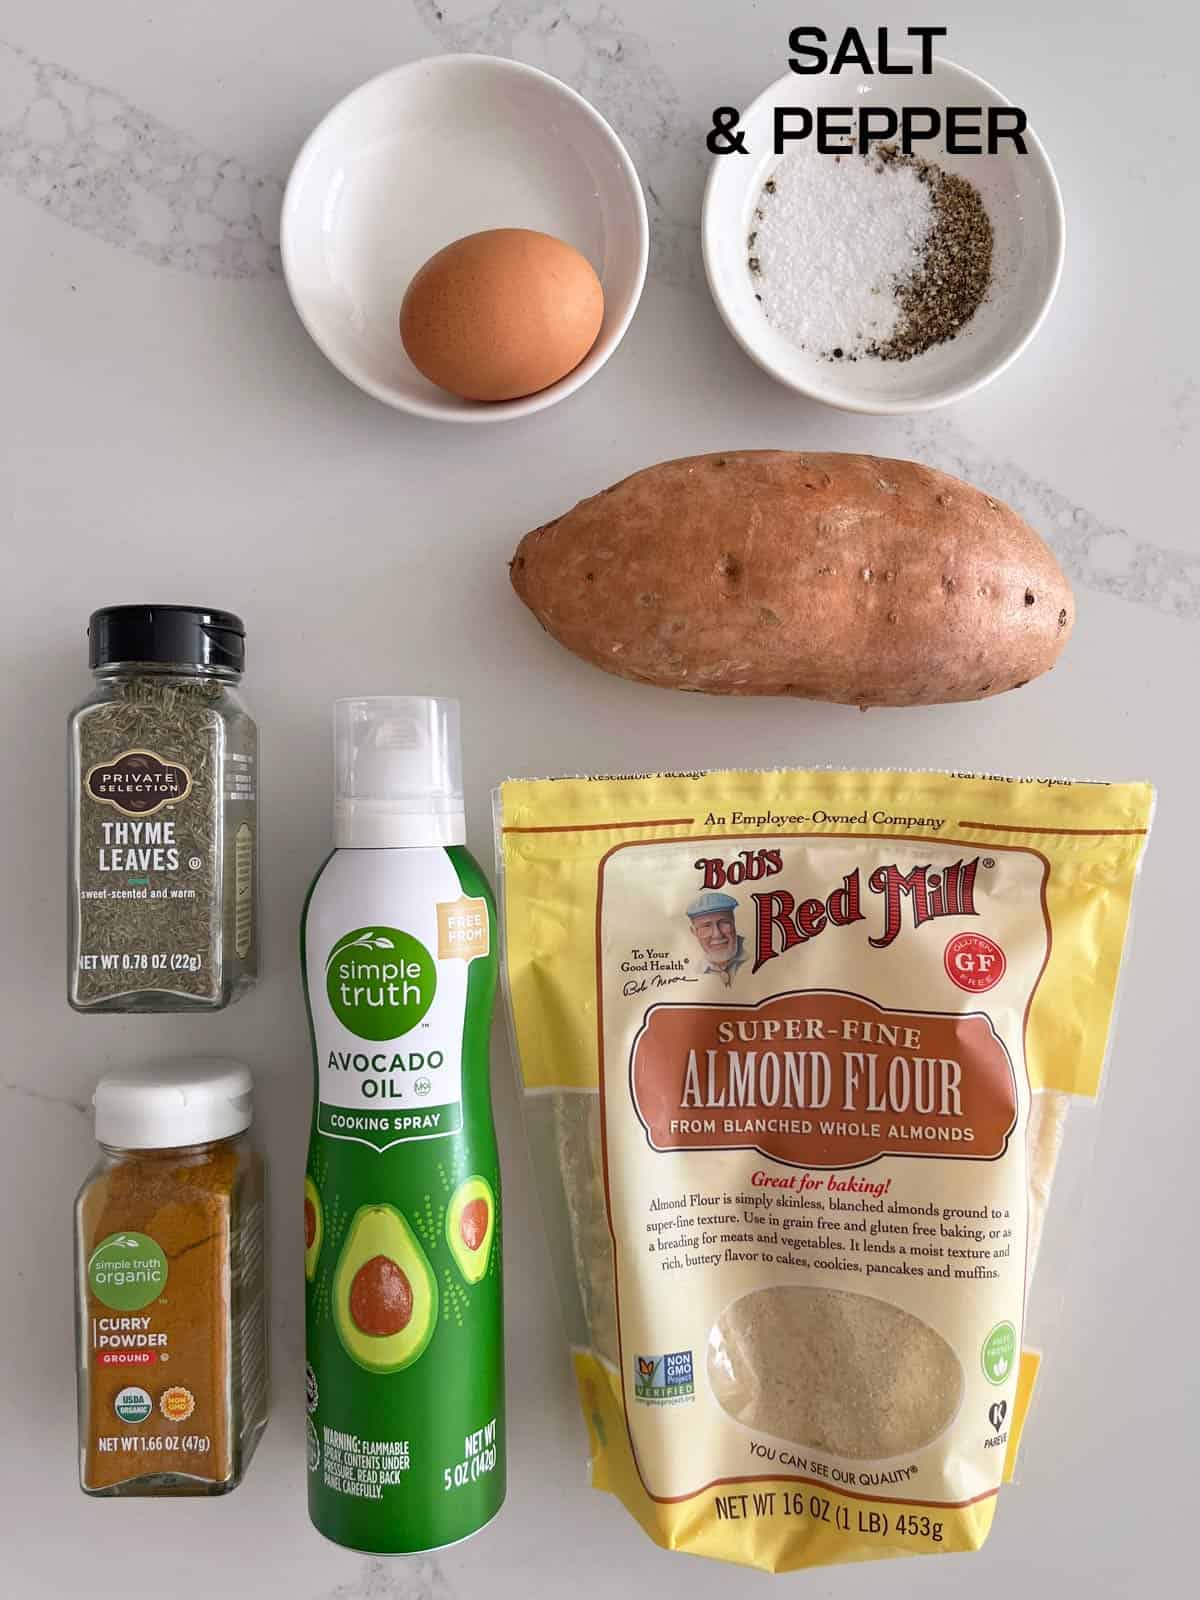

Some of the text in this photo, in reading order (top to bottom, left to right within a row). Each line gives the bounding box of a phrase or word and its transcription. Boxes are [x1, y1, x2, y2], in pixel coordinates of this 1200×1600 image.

[99, 784, 178, 792] SELECTION
[102, 773, 175, 783] PRIVATE
[704, 810, 945, 830] An Employee-Owned Company
[102, 822, 176, 845] THYME
[99, 848, 178, 871] LEAVES
[695, 848, 784, 891] Bob's
[80, 888, 196, 899] sweet-scented and warm
[751, 867, 866, 975] Red
[101, 955, 119, 969] WT
[123, 954, 148, 969] 0.78
[151, 954, 167, 969] OZ
[170, 954, 201, 971] (22g)
[631, 949, 670, 959] To Your
[955, 952, 995, 972] GF
[339, 959, 421, 983] simple
[621, 961, 648, 972] Good
[339, 980, 421, 1007] truth
[718, 1019, 921, 1050] SUPER-FINE
[328, 1050, 444, 1072] AVOCADO
[361, 1079, 402, 1098] OIL
[680, 1048, 963, 1116] ALMOND FLOUR
[330, 1113, 441, 1130] COOKING SPRAY
[670, 1119, 975, 1142] FROM BLANCHED WHOLE ALMONDS
[751, 1170, 892, 1198] Great for baking!
[649, 1195, 687, 1212] Almond
[689, 1193, 720, 1208] Flour
[723, 1193, 733, 1205] is
[735, 1192, 773, 1208] simply
[776, 1195, 825, 1211] skinless,
[829, 1197, 884, 1213] blanched
[887, 1200, 940, 1217] almonds
[943, 1206, 988, 1220] ground
[991, 1208, 1002, 1219] to
[646, 1211, 1012, 1242] super-fine texture. Use in grain free and gluten free baking, or as
[648, 1231, 1010, 1259] a breading for meats and vegetables. It lends a moist texture and
[95, 1258, 161, 1270] simple truth
[661, 1249, 1000, 1279] rich, buttery flavor to cakes, cookies, pancakes and muffins.
[95, 1268, 161, 1286] organic
[99, 1317, 151, 1331] CURRY
[99, 1333, 168, 1348] POWDER
[103, 1354, 150, 1363] GROUND
[667, 1353, 690, 1367] NON
[667, 1364, 692, 1376] GMO
[122, 1395, 145, 1404] USDA
[636, 1384, 693, 1398] VERIFIED
[99, 1436, 210, 1452] NET WT 1.66 OZ (47g)
[323, 1424, 361, 1454] WARNING:
[362, 1440, 409, 1455] FLAMMABLE
[465, 1418, 496, 1459] NET WT
[344, 1451, 381, 1470] CONTENTS
[382, 1455, 410, 1471] UNDER
[444, 1444, 497, 1491] 5 OZ (142g)
[750, 1441, 776, 1460] YOU
[779, 1452, 807, 1471] CAN
[810, 1462, 829, 1478] SEE
[832, 1468, 856, 1486] OUR
[357, 1468, 378, 1484] READ
[380, 1470, 401, 1485] BACK
[342, 1479, 384, 1500] CAREFULLY.
[715, 1492, 944, 1542] NET WT 16 OZ (1 LB) 453g
